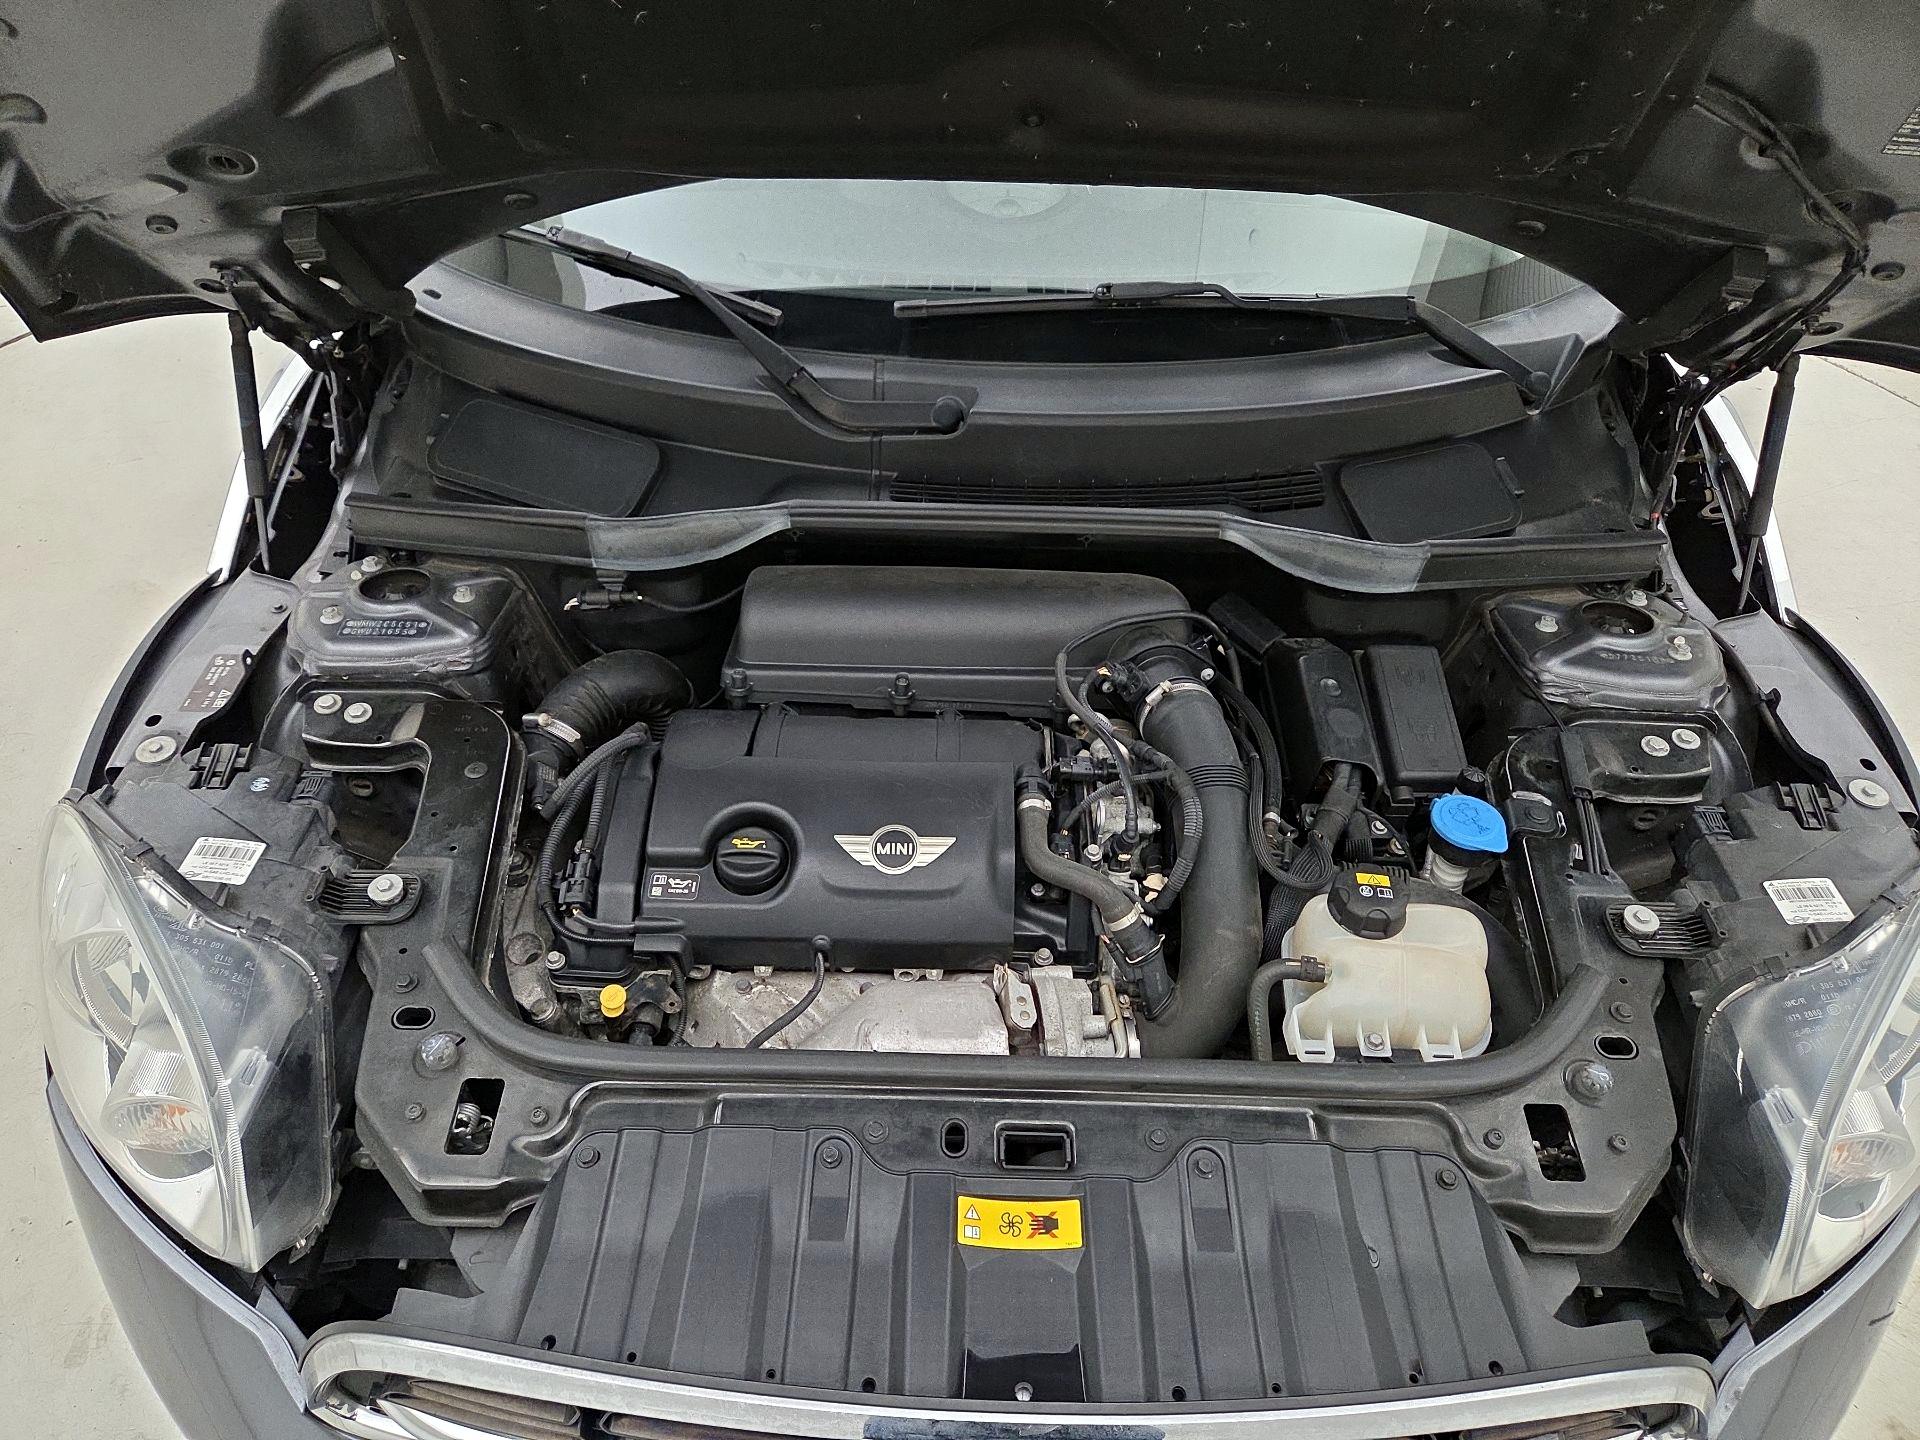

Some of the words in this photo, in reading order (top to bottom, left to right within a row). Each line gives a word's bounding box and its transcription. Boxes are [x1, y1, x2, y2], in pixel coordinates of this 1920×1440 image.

[876, 842, 913, 855] MINI
[175, 932, 190, 942] 305
[1819, 981, 1834, 990] 305
